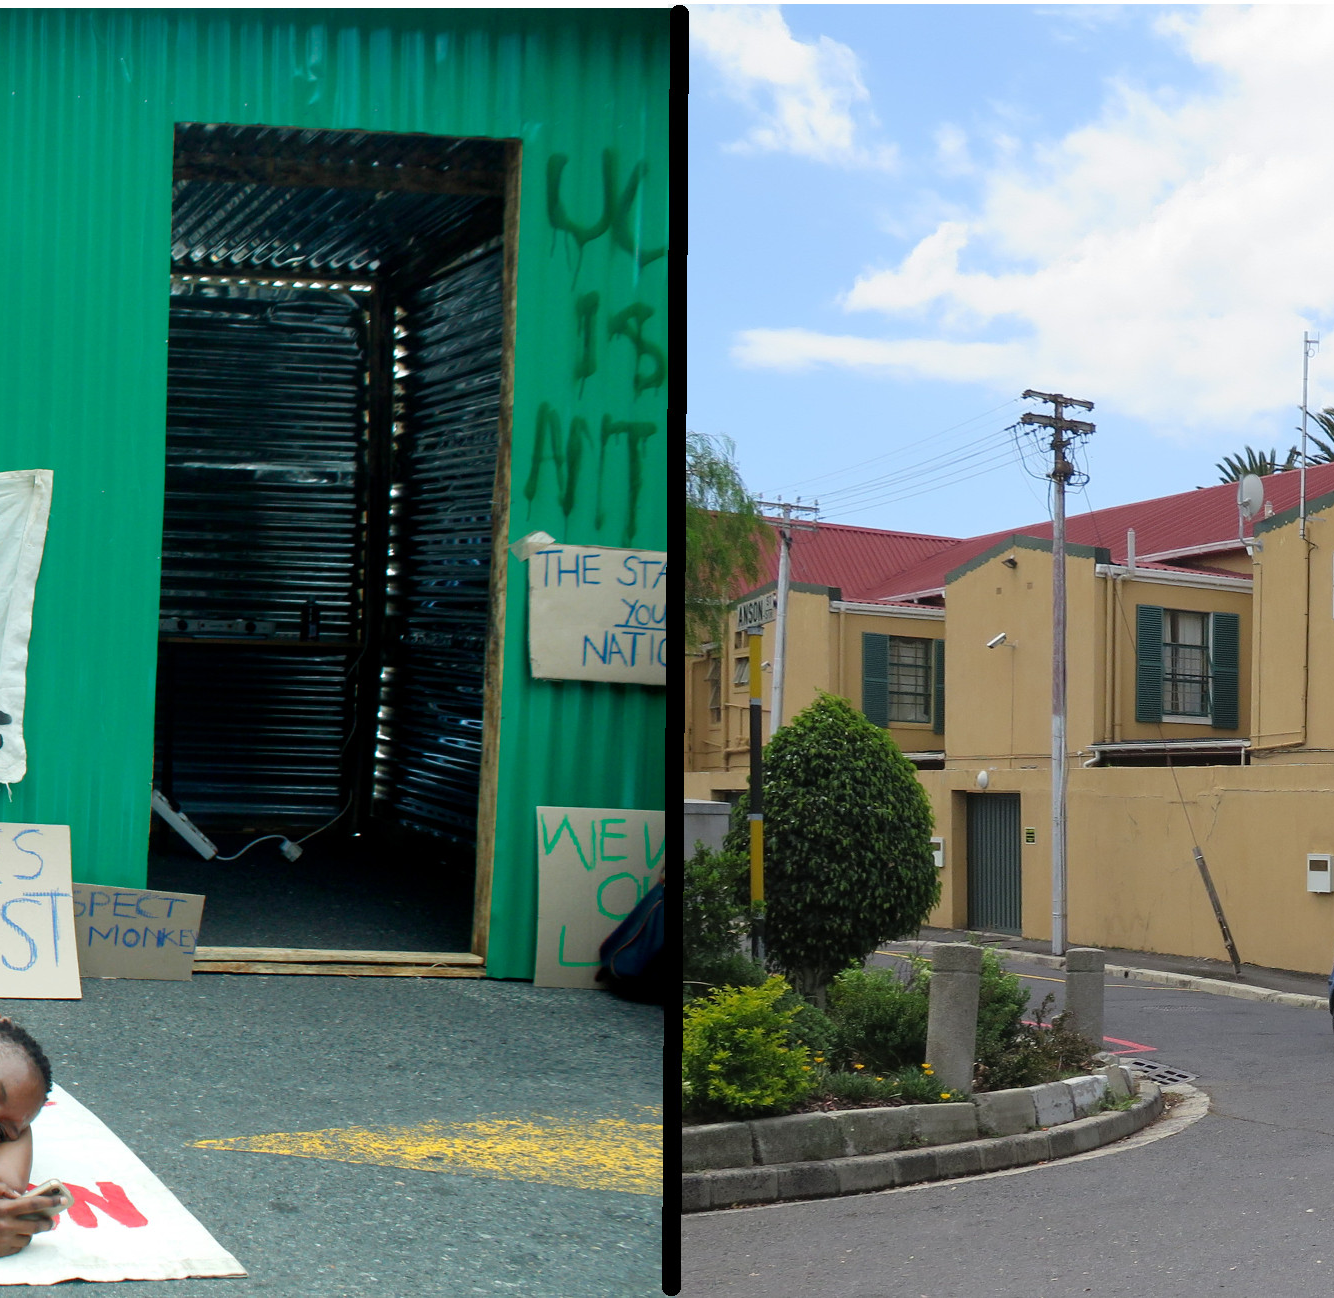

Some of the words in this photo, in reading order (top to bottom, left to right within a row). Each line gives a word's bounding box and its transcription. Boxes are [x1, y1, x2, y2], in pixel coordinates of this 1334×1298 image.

[535, 549, 602, 588] THE
[540, 813, 628, 872] WE
[73, 890, 187, 918] SPECT
